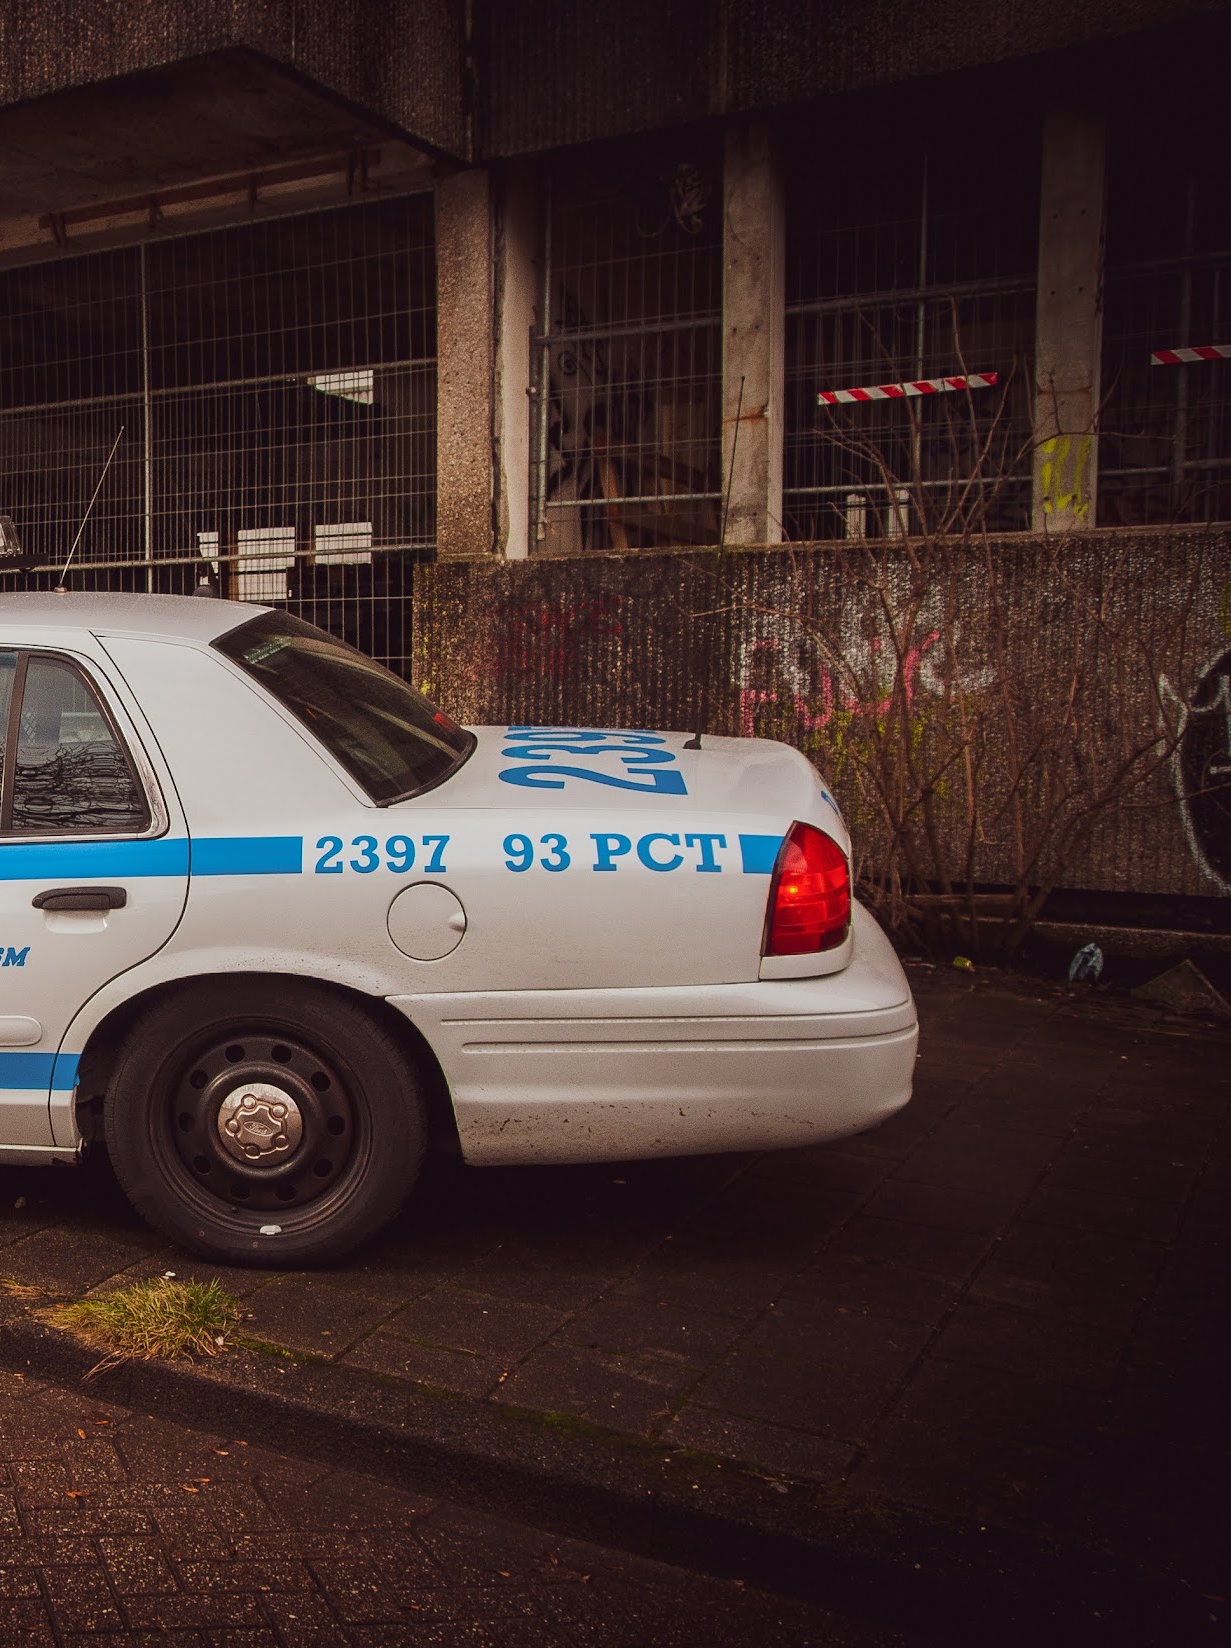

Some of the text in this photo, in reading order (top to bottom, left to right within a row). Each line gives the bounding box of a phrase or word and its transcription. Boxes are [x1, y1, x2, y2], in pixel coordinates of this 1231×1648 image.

[315, 833, 727, 874] 2397 93 PCT
